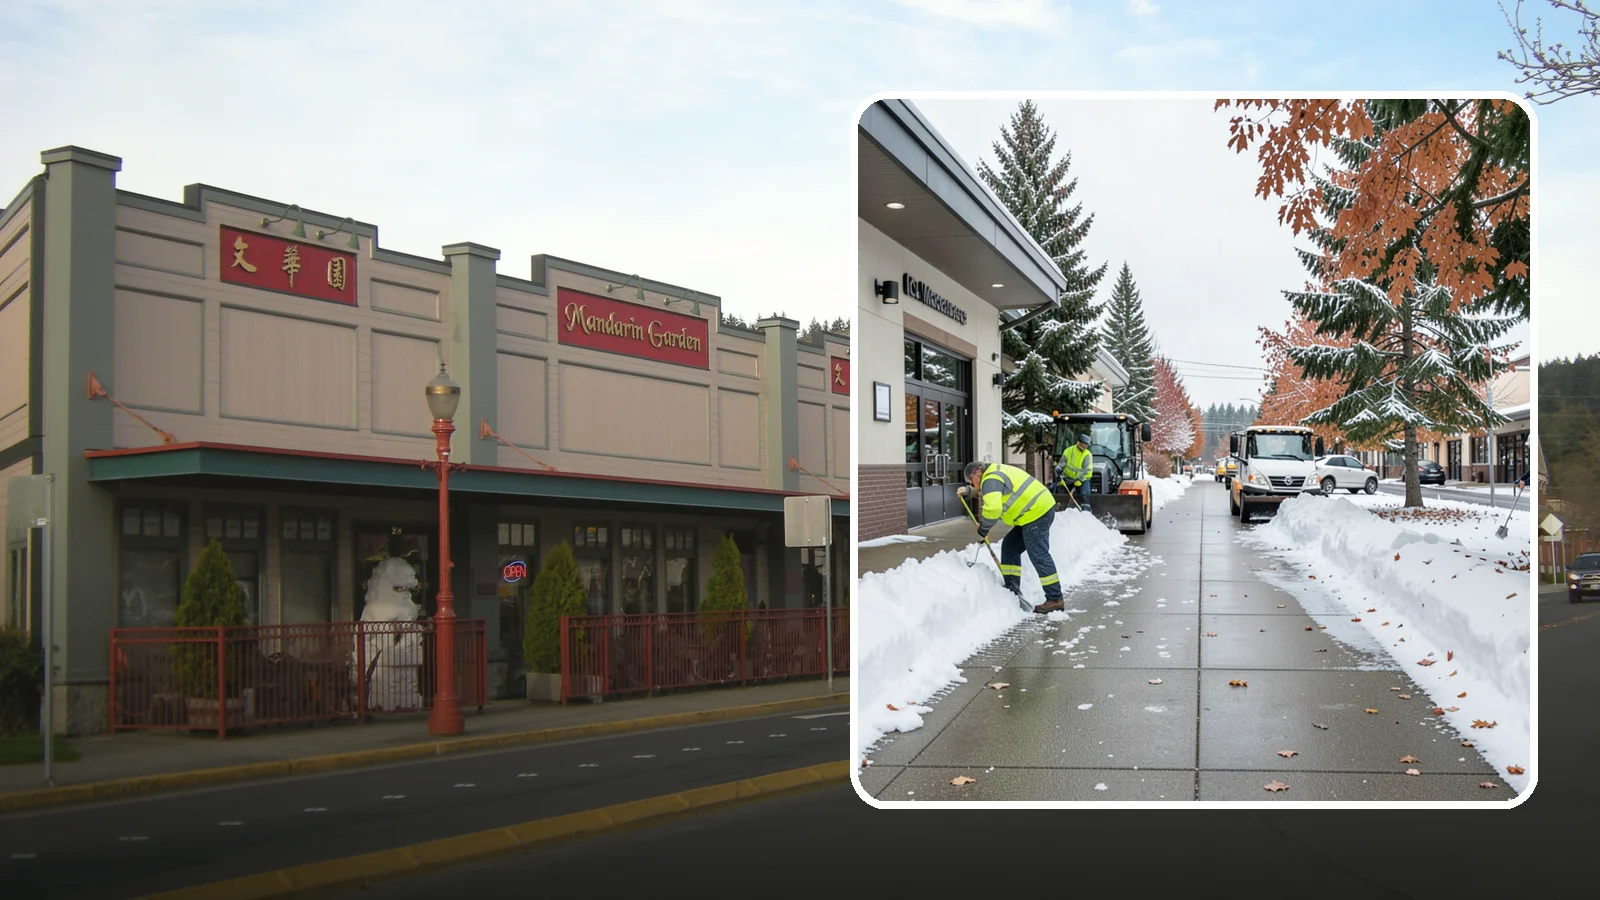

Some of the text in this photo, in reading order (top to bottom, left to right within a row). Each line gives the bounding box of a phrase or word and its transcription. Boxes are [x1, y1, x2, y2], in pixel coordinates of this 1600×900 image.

[230, 235, 347, 291] 文華園
[564, 301, 702, 353] Mandarin Garden
[503, 565, 527, 578] OPEN
